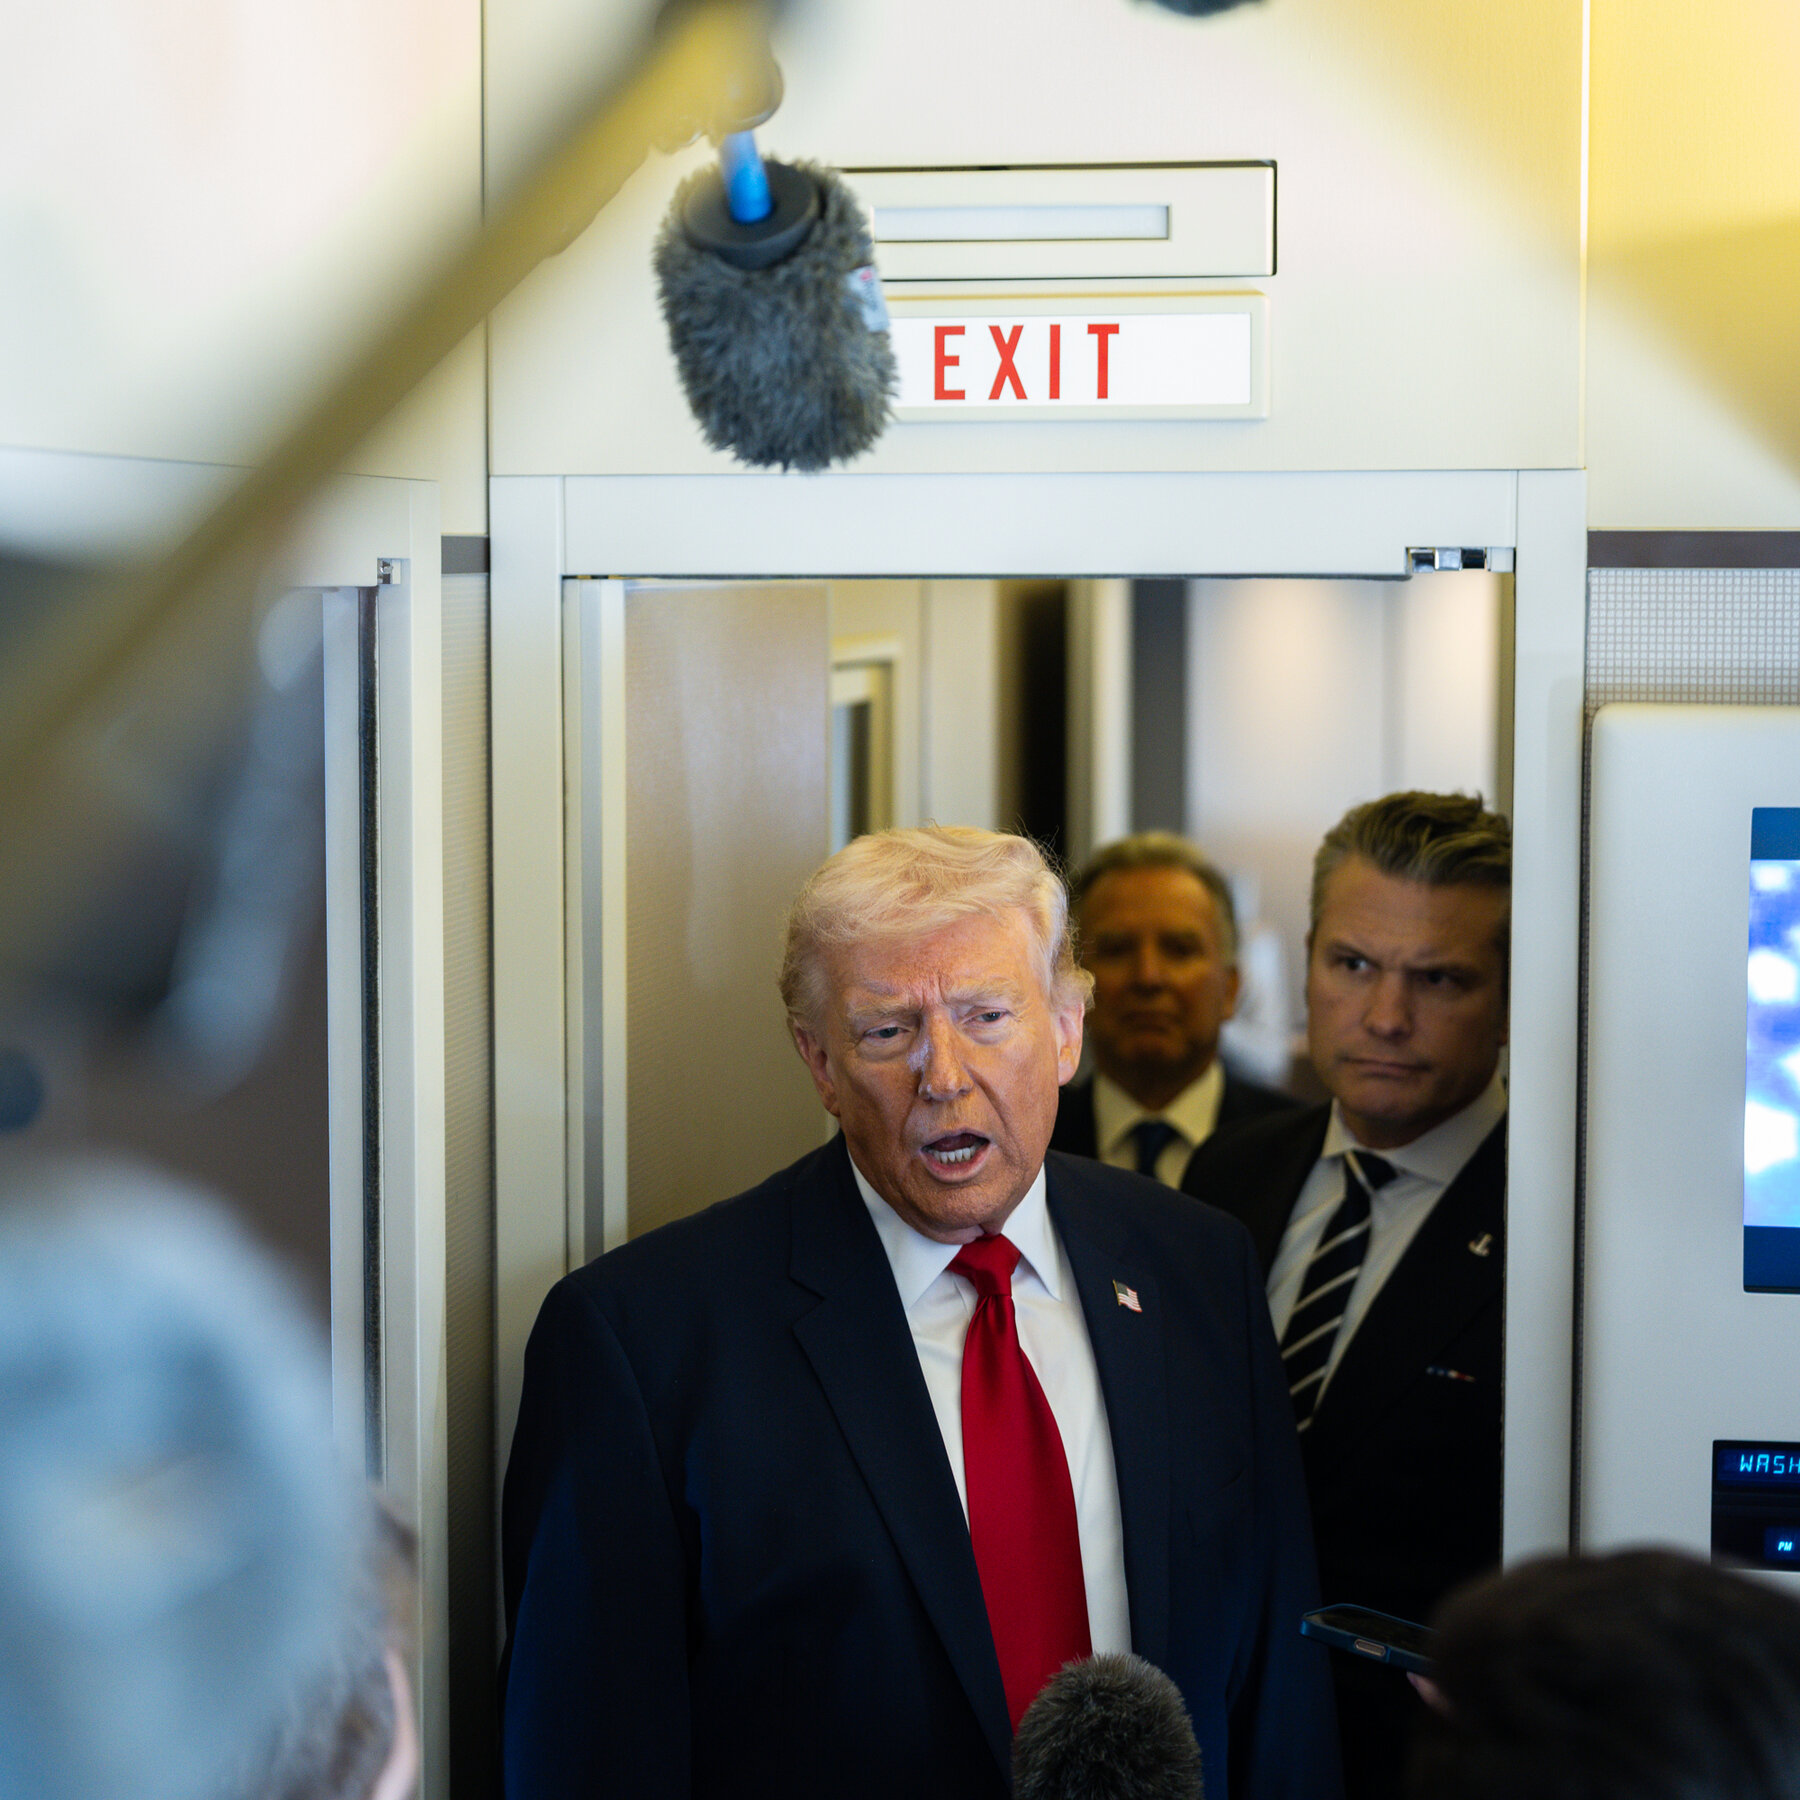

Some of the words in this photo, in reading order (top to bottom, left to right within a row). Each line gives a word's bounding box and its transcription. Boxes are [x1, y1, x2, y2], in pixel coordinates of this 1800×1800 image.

[934, 323, 1120, 400] EXIT
[1739, 1453, 1800, 1474] WASH
[1777, 1540, 1793, 1552] PM
